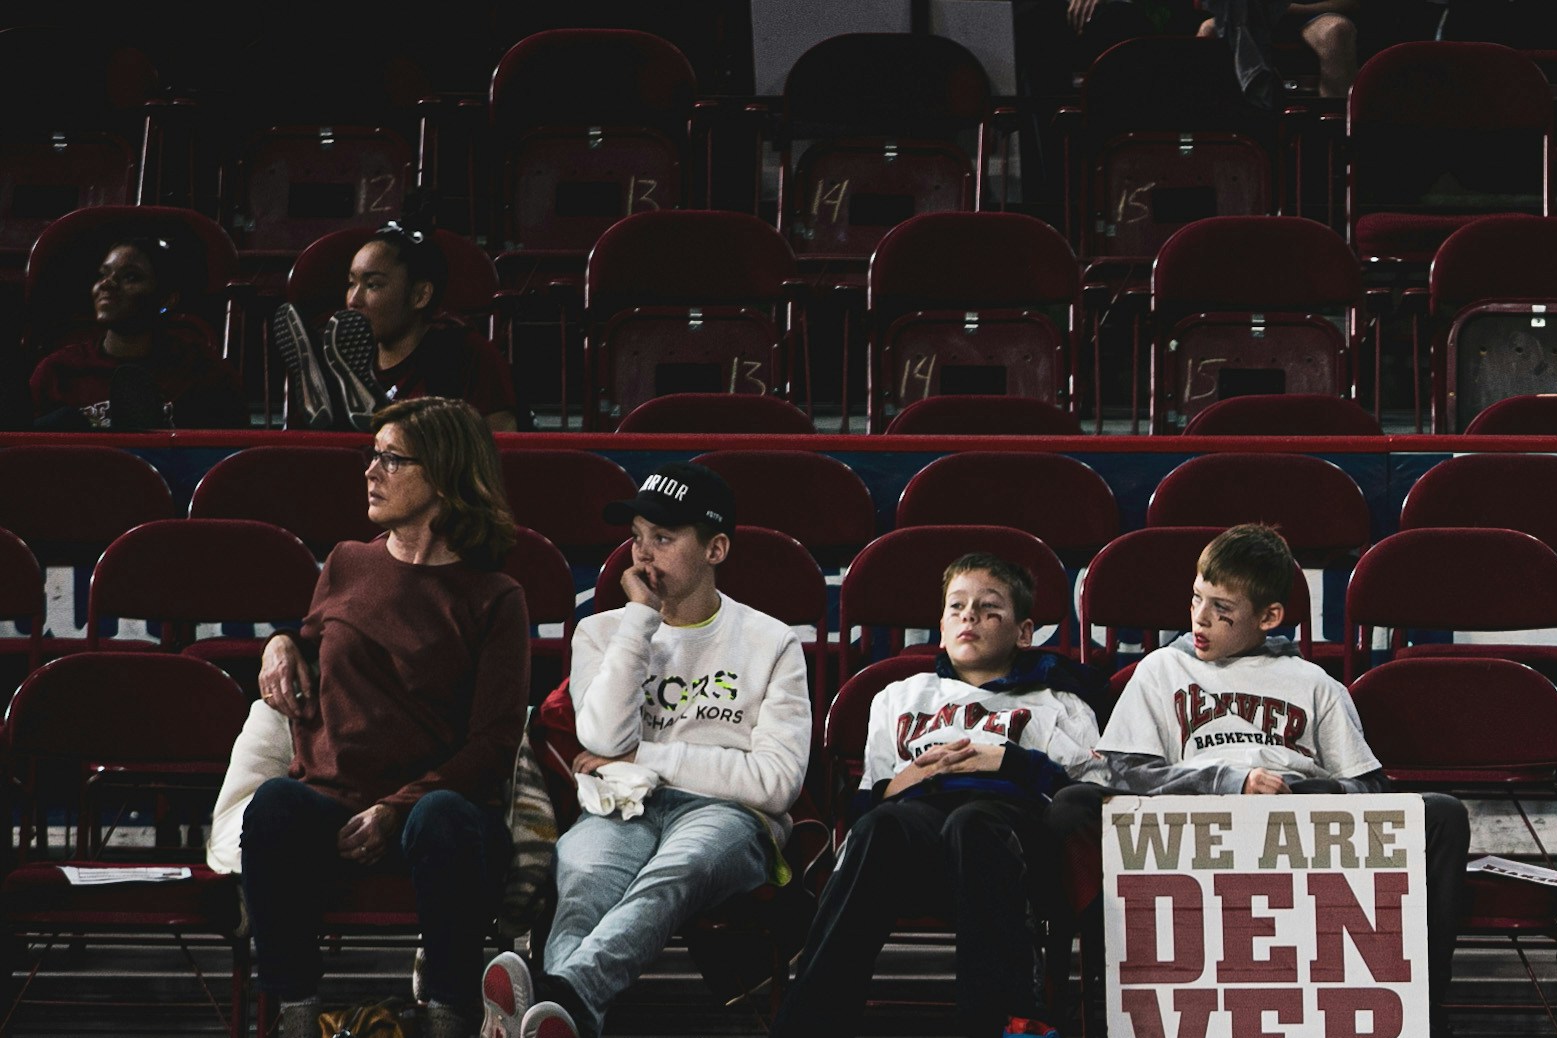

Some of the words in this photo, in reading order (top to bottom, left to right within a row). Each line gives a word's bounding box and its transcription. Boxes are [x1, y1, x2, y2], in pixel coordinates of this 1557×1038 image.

[357, 173, 397, 215] 12
[626, 175, 661, 216] 13
[811, 178, 850, 224] 14
[1116, 181, 1157, 224] 15
[729, 356, 767, 397] 13
[899, 353, 937, 399] 14
[1183, 357, 1228, 403] 15
[695, 704, 745, 725] KORS
[1111, 811, 1234, 870] WE
[1258, 811, 1407, 870] ARE
[1117, 872, 1412, 985] DEN
